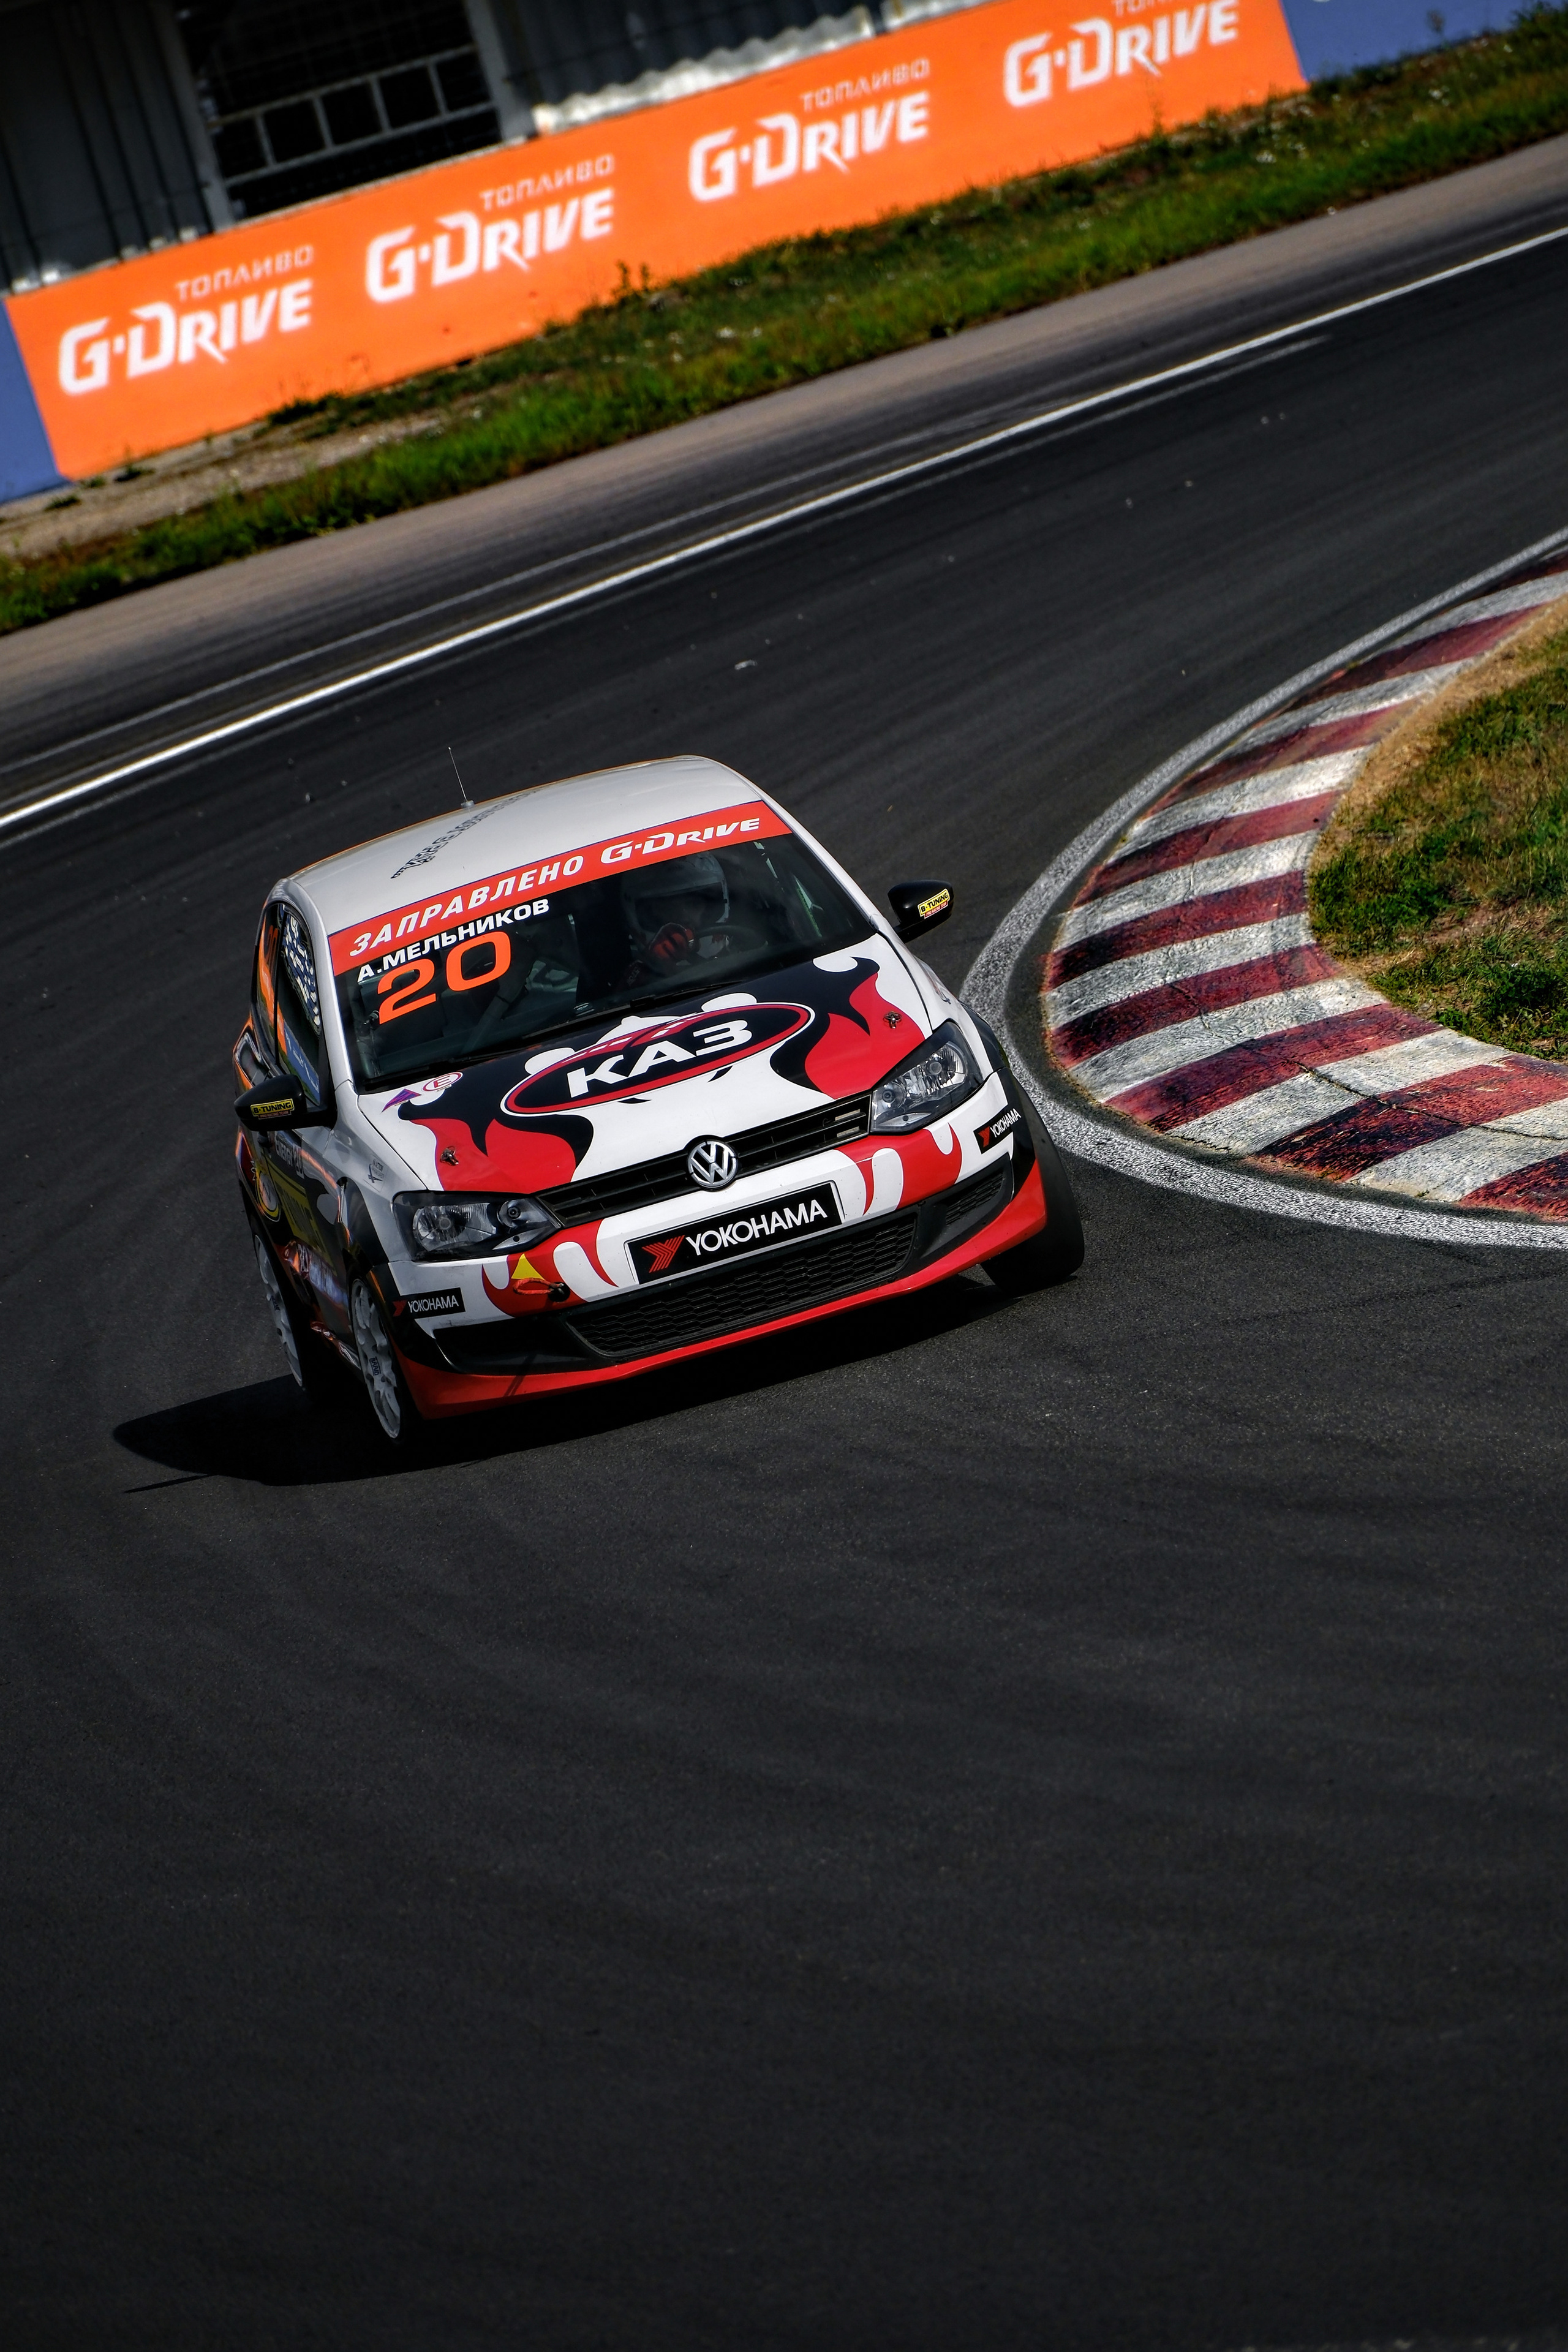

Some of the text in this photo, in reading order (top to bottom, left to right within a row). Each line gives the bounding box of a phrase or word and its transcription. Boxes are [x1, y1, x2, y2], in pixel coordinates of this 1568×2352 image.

[801, 58, 930, 111] ТОПЛИВО
[480, 154, 615, 211] ТОПЛИВО
[175, 245, 314, 302] ТОПЛИВО
[350, 856, 584, 957] ЗАПРАВЛЕНО
[358, 899, 549, 982] А.МЕЛЬНИКОВ
[377, 931, 511, 1024] 20
[990, 1108, 1022, 1138] YOKOHAMA
[685, 1199, 828, 1256] YOKOHAMA
[407, 1295, 459, 1313] YOKOHAMA
